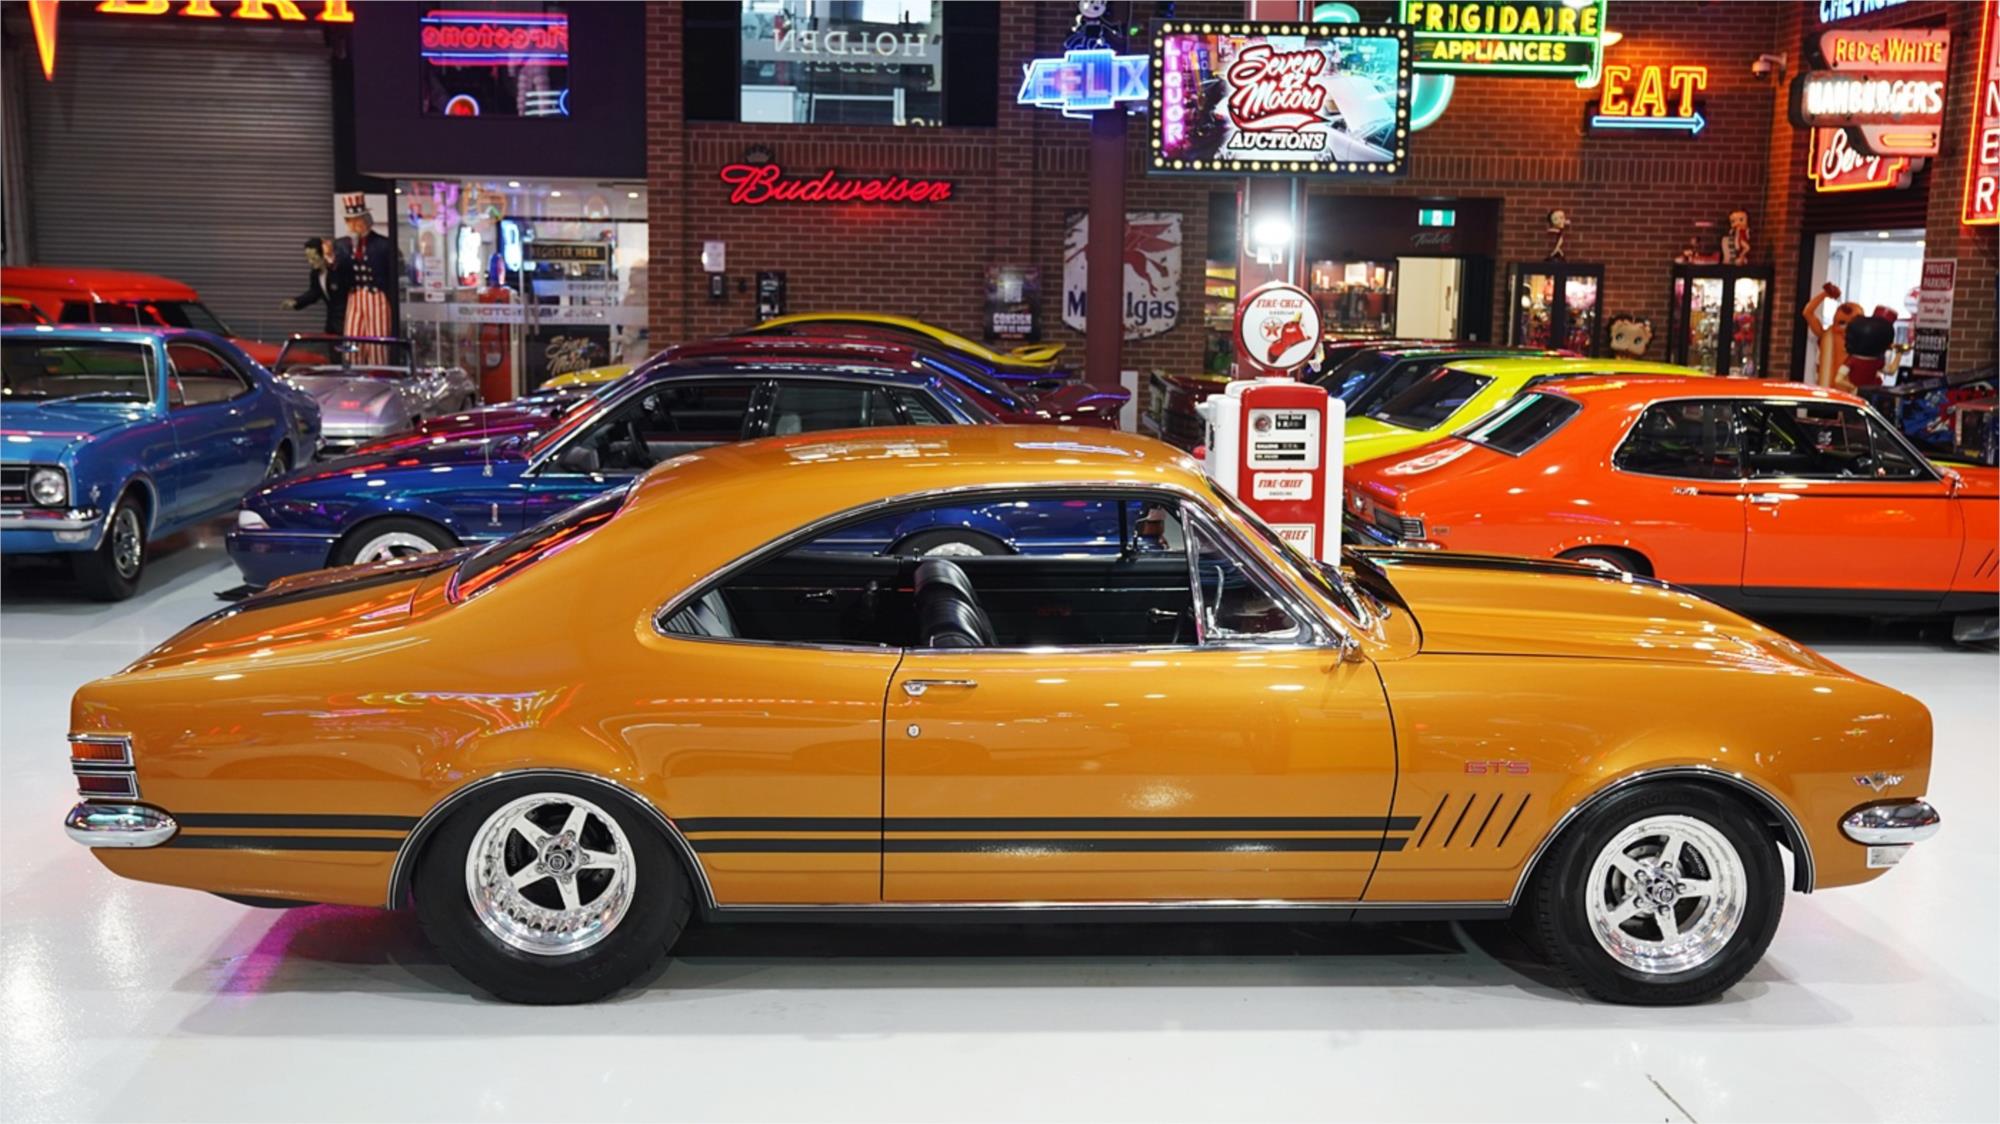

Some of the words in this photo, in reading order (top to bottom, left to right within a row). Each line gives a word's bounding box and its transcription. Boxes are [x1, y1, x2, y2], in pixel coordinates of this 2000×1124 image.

[1408, 3, 1598, 35] FRIGIDAIRE
[1229, 45, 1323, 81] Seven
[1432, 40, 1566, 62] APPLIANCES
[1836, 38, 1869, 62] RED
[1870, 44, 1883, 62] &
[1886, 38, 1943, 62] WHITE
[1035, 60, 1149, 98] FELIX
[1165, 37, 1184, 144] LIQUOR
[1602, 65, 1707, 117] EAT
[1230, 80, 1323, 117] Motors
[1806, 80, 1944, 115] HAMBURGERS
[1228, 132, 1326, 150] AUCTIONS
[721, 164, 951, 204] Budweiser
[1068, 291, 1176, 326] Mlgas
[1464, 760, 1530, 775] GTS
